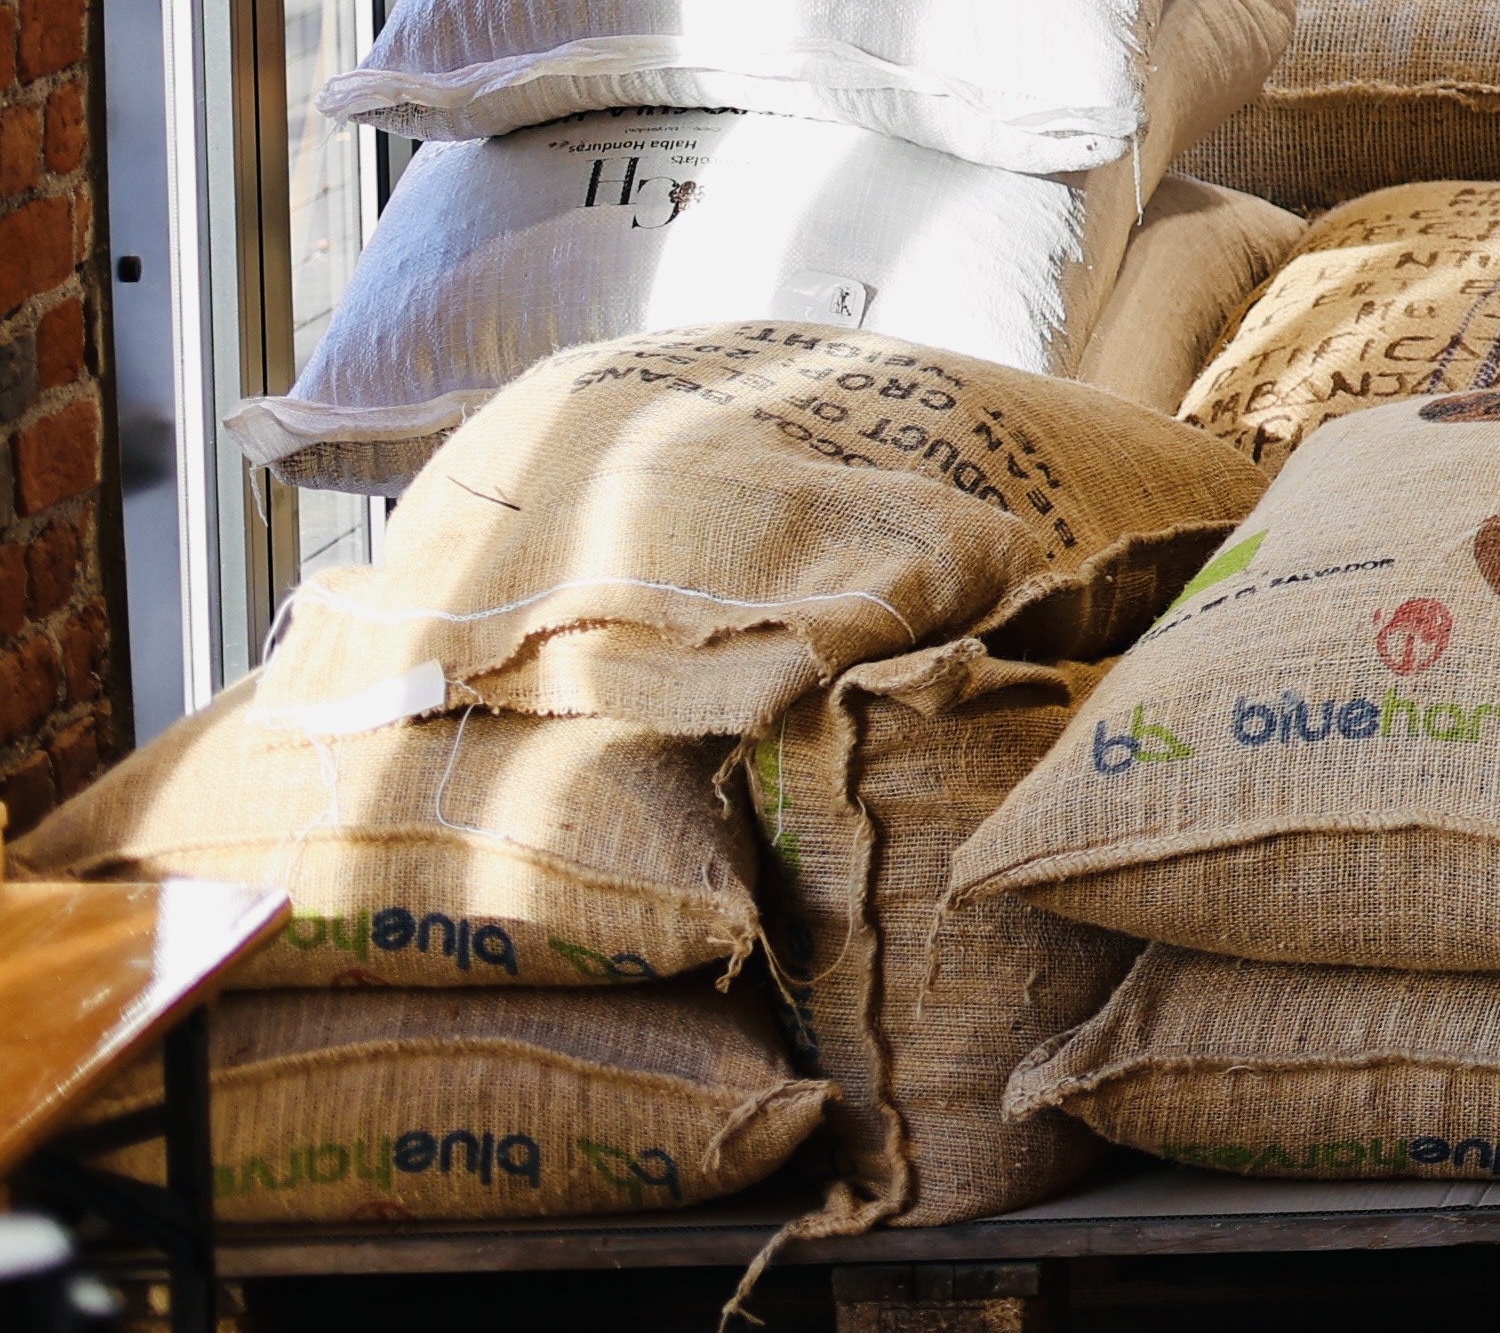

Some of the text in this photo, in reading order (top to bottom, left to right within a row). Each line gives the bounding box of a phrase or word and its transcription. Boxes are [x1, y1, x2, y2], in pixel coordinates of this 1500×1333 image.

[567, 137, 697, 154] Halba Honduras
[568, 364, 877, 468] OCOA BEANS
[796, 395, 852, 425] OF
[858, 416, 1014, 513] ODUCT
[1268, 555, 1397, 589] SALVADOR
